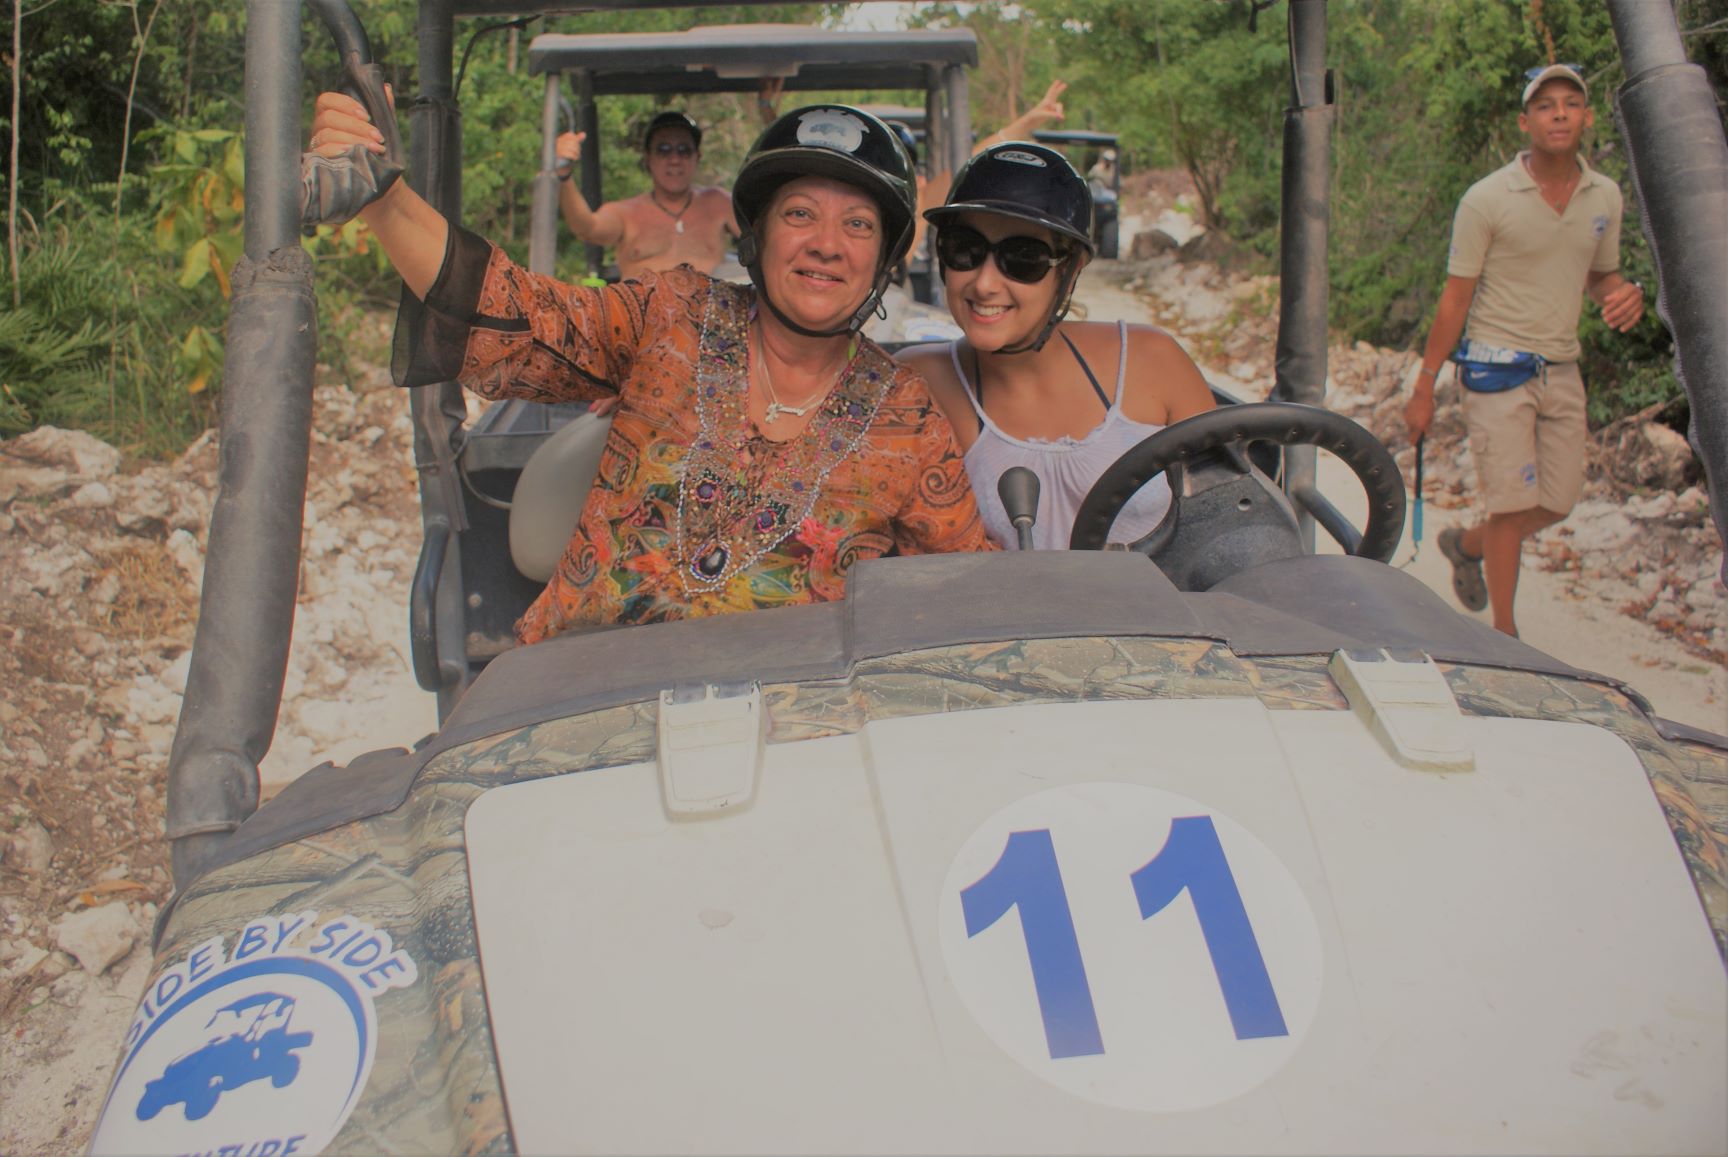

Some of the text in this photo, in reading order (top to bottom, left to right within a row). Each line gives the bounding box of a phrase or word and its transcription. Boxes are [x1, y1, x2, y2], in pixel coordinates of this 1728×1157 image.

[235, 916, 306, 961] BY
[309, 920, 407, 989] SIDE
[959, 814, 1289, 1060] 11
